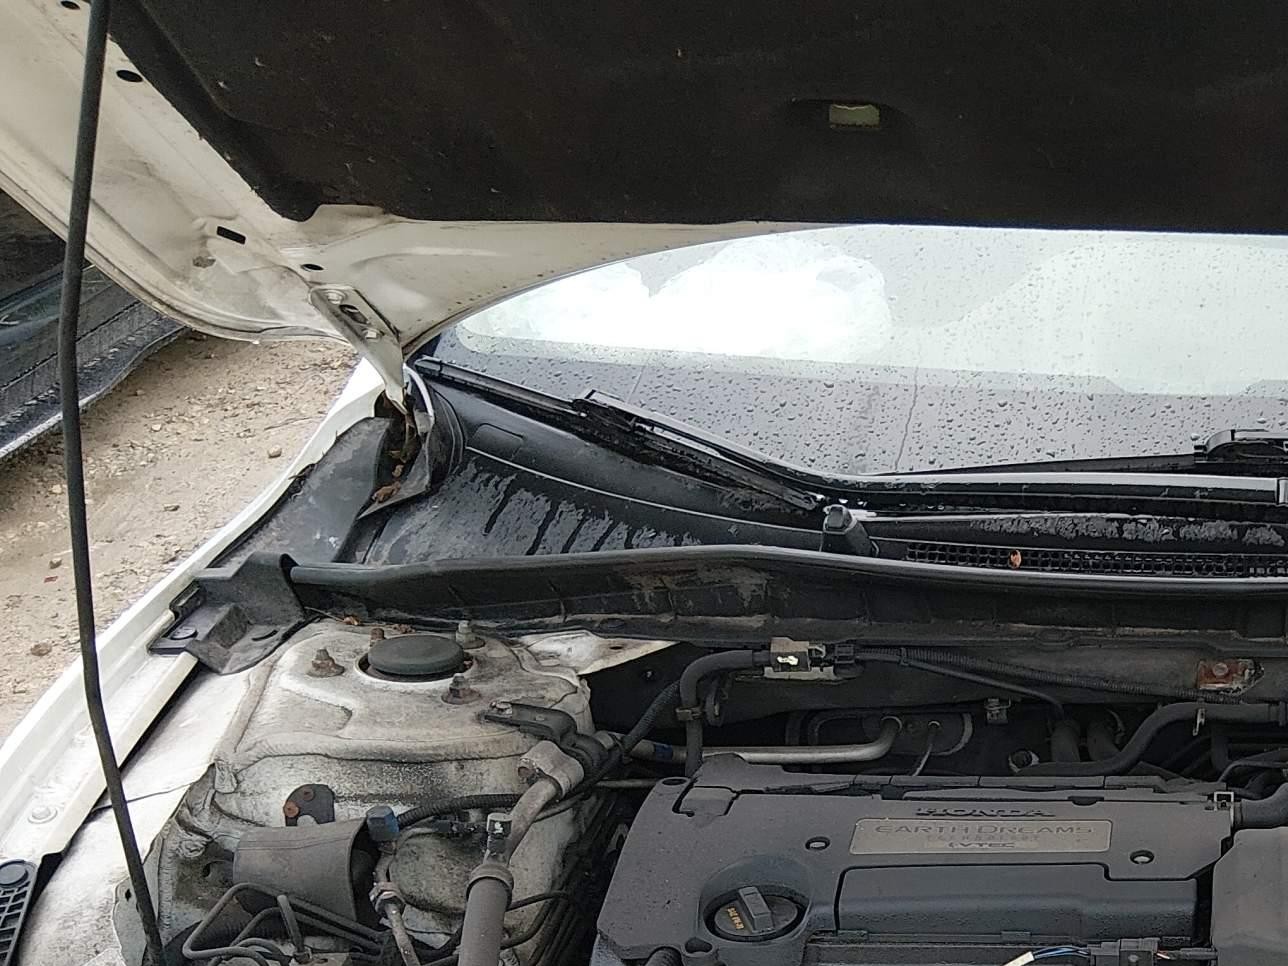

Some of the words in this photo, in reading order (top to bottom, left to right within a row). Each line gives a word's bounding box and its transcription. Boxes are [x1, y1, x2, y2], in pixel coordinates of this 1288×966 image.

[915, 806, 1055, 817] HONDA
[874, 824, 969, 834] EARTH
[976, 824, 1094, 834] DREAMS
